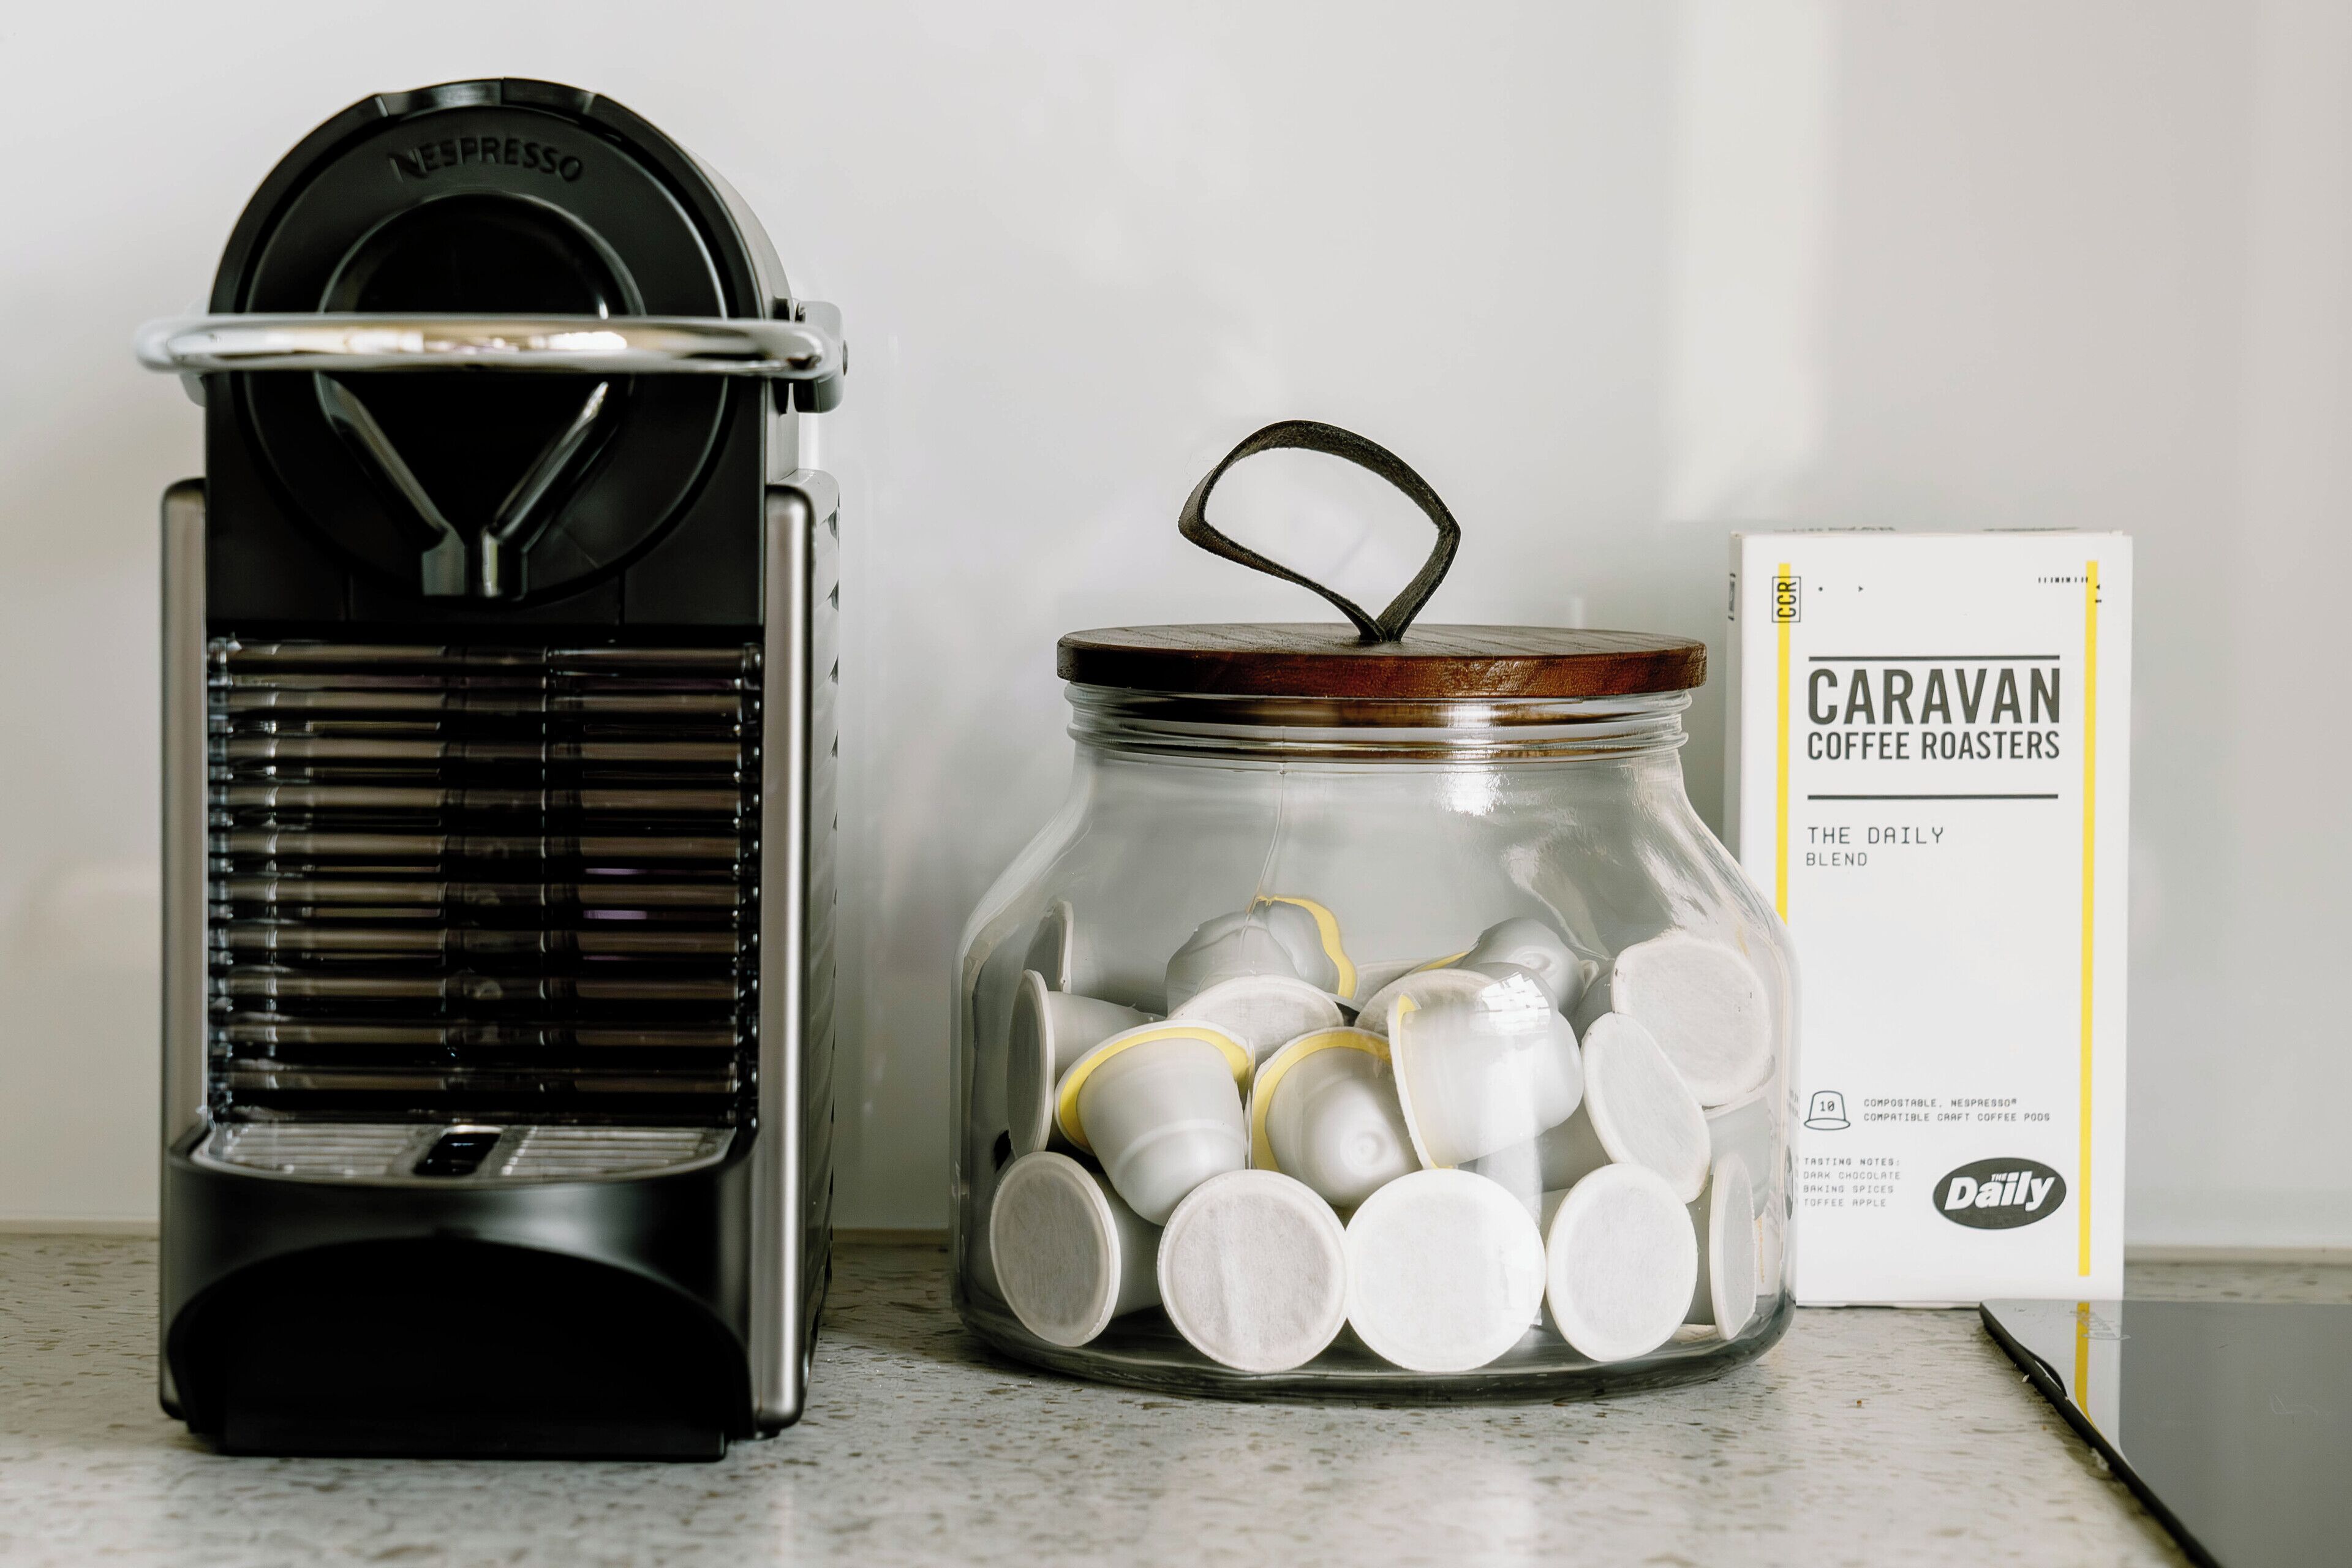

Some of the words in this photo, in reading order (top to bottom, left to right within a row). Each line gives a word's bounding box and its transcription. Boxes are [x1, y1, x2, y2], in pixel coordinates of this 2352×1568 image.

[386, 134, 584, 184] NESPRESSO
[1777, 582, 1796, 618] CCR
[1807, 668, 2060, 725] CARAVAN
[1807, 731, 1910, 761] COFFEE
[1921, 730, 2060, 760] ROASTERS
[1807, 826, 1850, 845] THE
[1868, 826, 1943, 845] DAILY
[1806, 852, 1868, 867] BLEND
[1820, 1100, 1835, 1112] 10
[1864, 1113, 1929, 1121] COMPATIBLE
[1937, 1112, 1970, 1121] CRAFT
[1977, 1112, 2016, 1122] COFFEE
[2024, 1112, 2050, 1121] PODS
[1805, 1157, 1852, 1166] TASTING
[1803, 1170, 1830, 1180] DARK
[1838, 1171, 1900, 1180] CHOCOLATE
[1803, 1185, 1844, 1193] BAKING
[1852, 1185, 1894, 1194] SPICES
[1944, 1170, 2056, 1212] Daily
[1804, 1198, 1844, 1207] TOFFEE
[1852, 1198, 1886, 1207] APPLE
